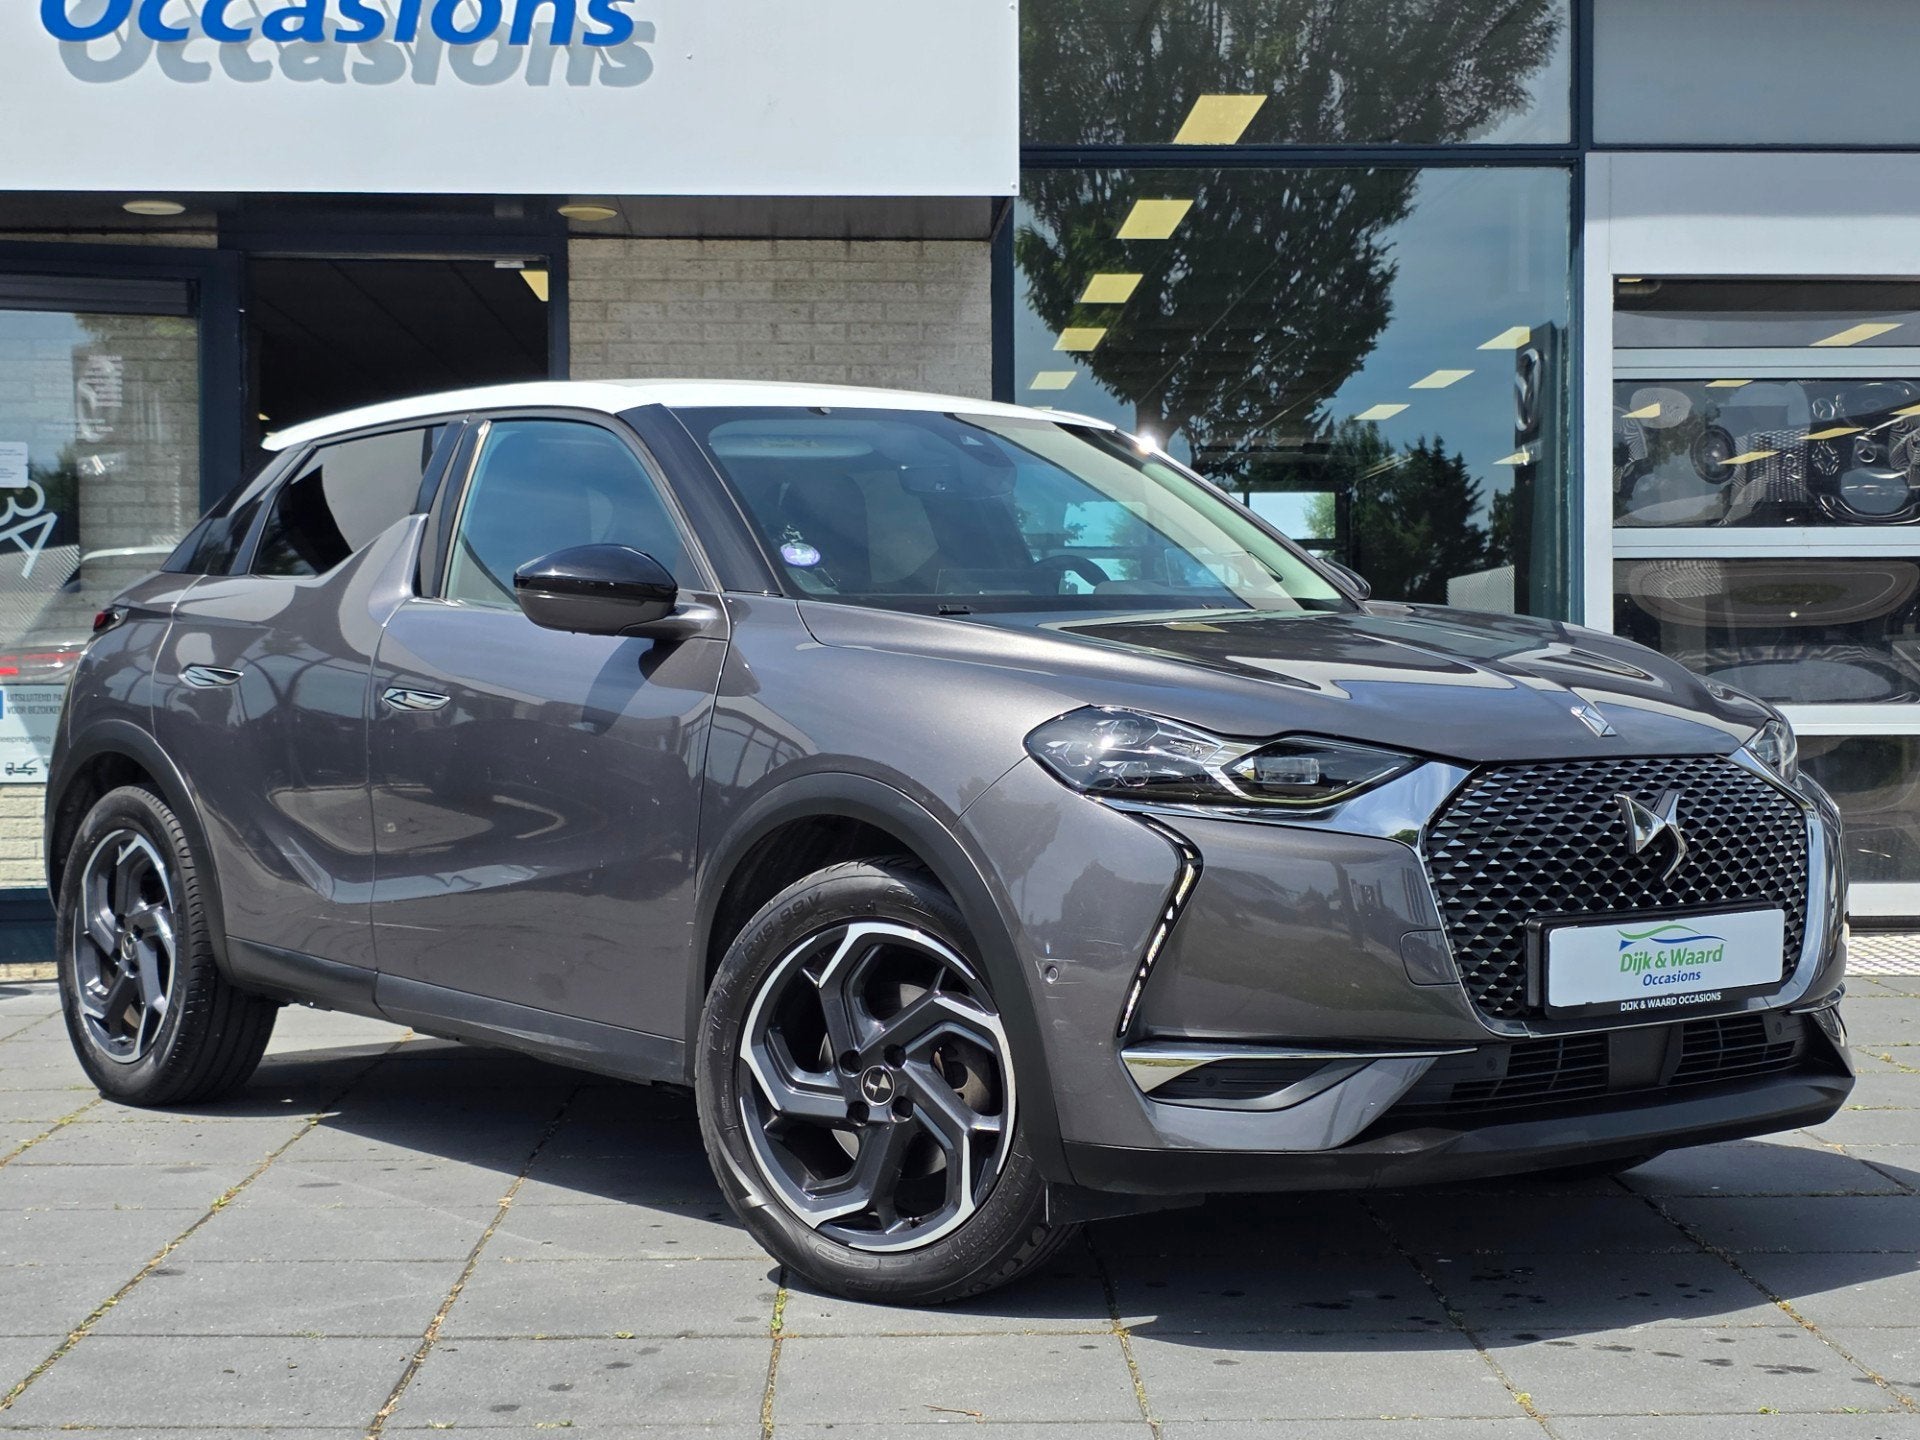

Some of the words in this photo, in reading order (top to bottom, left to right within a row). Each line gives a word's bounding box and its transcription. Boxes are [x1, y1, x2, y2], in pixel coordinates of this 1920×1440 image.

[1621, 952, 1652, 975] Dijk
[1655, 951, 1667, 968] &
[1670, 944, 1723, 967] Waard
[1643, 971, 1701, 986] Occasions
[1621, 1001, 1639, 1011] DIJK
[1640, 1000, 1648, 1009] &
[1647, 997, 1678, 1009] WAARD
[1678, 992, 1721, 1004] OCCASIONS
